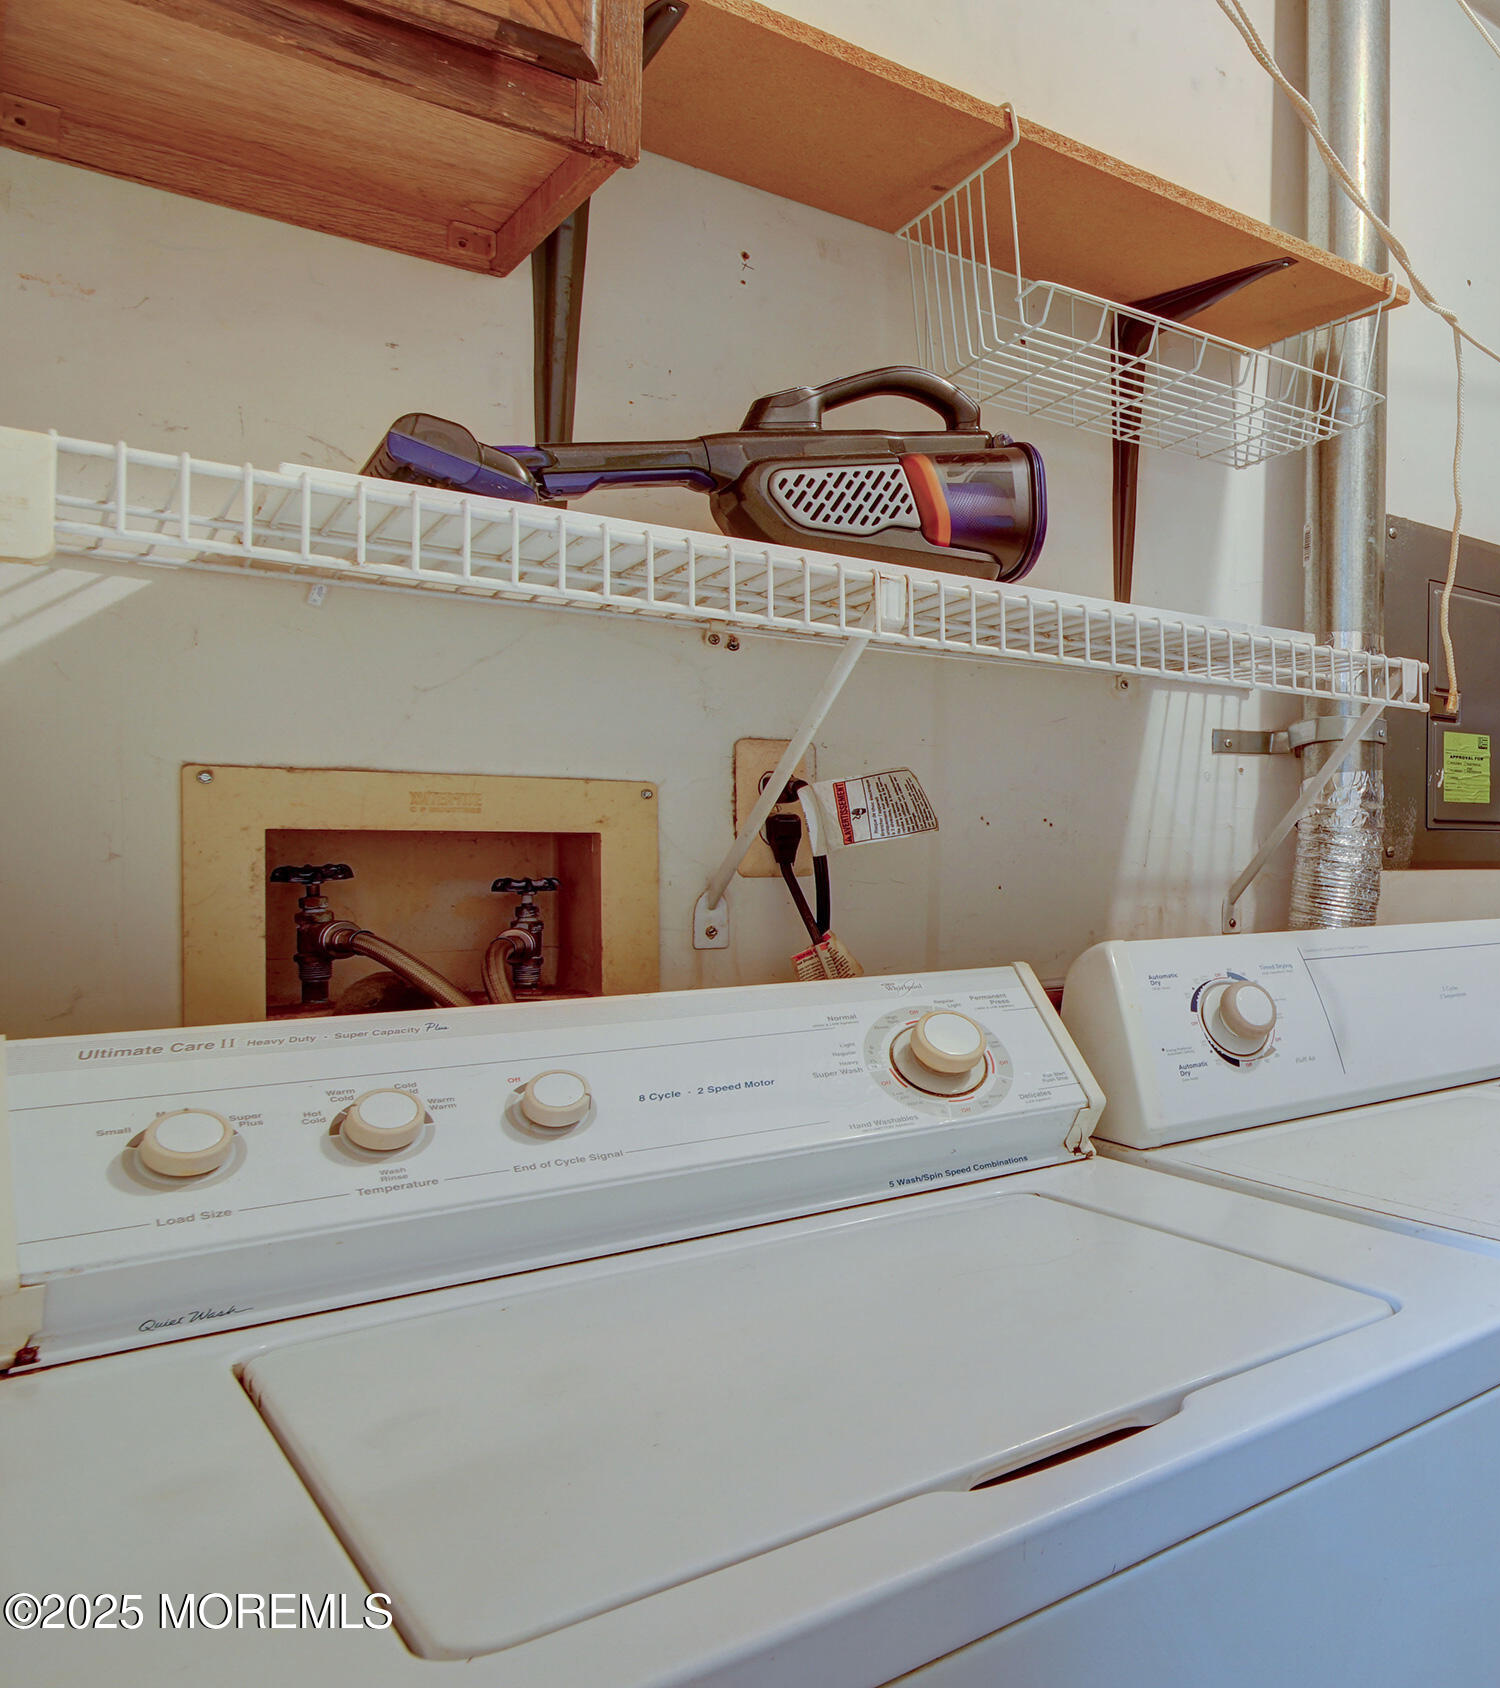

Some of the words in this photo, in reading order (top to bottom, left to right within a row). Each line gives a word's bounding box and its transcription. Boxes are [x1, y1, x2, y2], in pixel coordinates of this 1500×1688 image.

[835, 783, 852, 837] AVERTISSEMENT
[1148, 972, 1179, 981] Automatic
[969, 993, 1007, 1001] Permanent
[827, 1014, 857, 1022] Normal
[246, 1037, 285, 1047] Heavy
[289, 1034, 317, 1044] Duty
[335, 1030, 369, 1040] Super
[372, 1026, 421, 1038] Capacity
[424, 1022, 450, 1033] Plus
[78, 1045, 164, 1061] Ultimate
[170, 1040, 216, 1053] Care
[220, 1038, 236, 1049] II
[1178, 1061, 1209, 1071] Automatic
[812, 1071, 838, 1080] Super
[840, 1066, 863, 1075] Wash
[507, 1076, 521, 1084] Off
[394, 1082, 418, 1090] Cold
[638, 1094, 646, 1102] 8
[649, 1090, 681, 1103] Cycle
[697, 1087, 704, 1095] 2
[707, 1082, 742, 1095] Speed
[744, 1078, 775, 1089] Motor
[325, 1088, 356, 1097] Warm
[330, 1095, 355, 1103] Cold
[427, 1097, 455, 1105] Warm
[428, 1103, 457, 1111] Warm
[228, 1112, 263, 1122] Super
[302, 1110, 322, 1118] Hot
[238, 1119, 264, 1128] Plus
[301, 1116, 327, 1125] Cold
[849, 1122, 872, 1130] Hand
[874, 1115, 919, 1126] Washables
[96, 1127, 132, 1137] Small
[513, 1163, 537, 1174] End
[540, 1161, 551, 1169] of
[554, 1155, 586, 1169] Cycle
[589, 1150, 624, 1163] Signal
[379, 1167, 407, 1176] Wash
[889, 1180, 895, 1188] 5
[896, 1172, 943, 1186] Wash/Spin
[945, 1166, 971, 1177] Speed
[973, 1155, 1029, 1172] Combinations
[380, 1173, 408, 1182] Rinse
[356, 1178, 439, 1196] Temperature
[156, 1213, 196, 1227] Load
[201, 1209, 233, 1220] Size
[138, 1316, 185, 1332] Quiet
[188, 1305, 254, 1323] Wash
